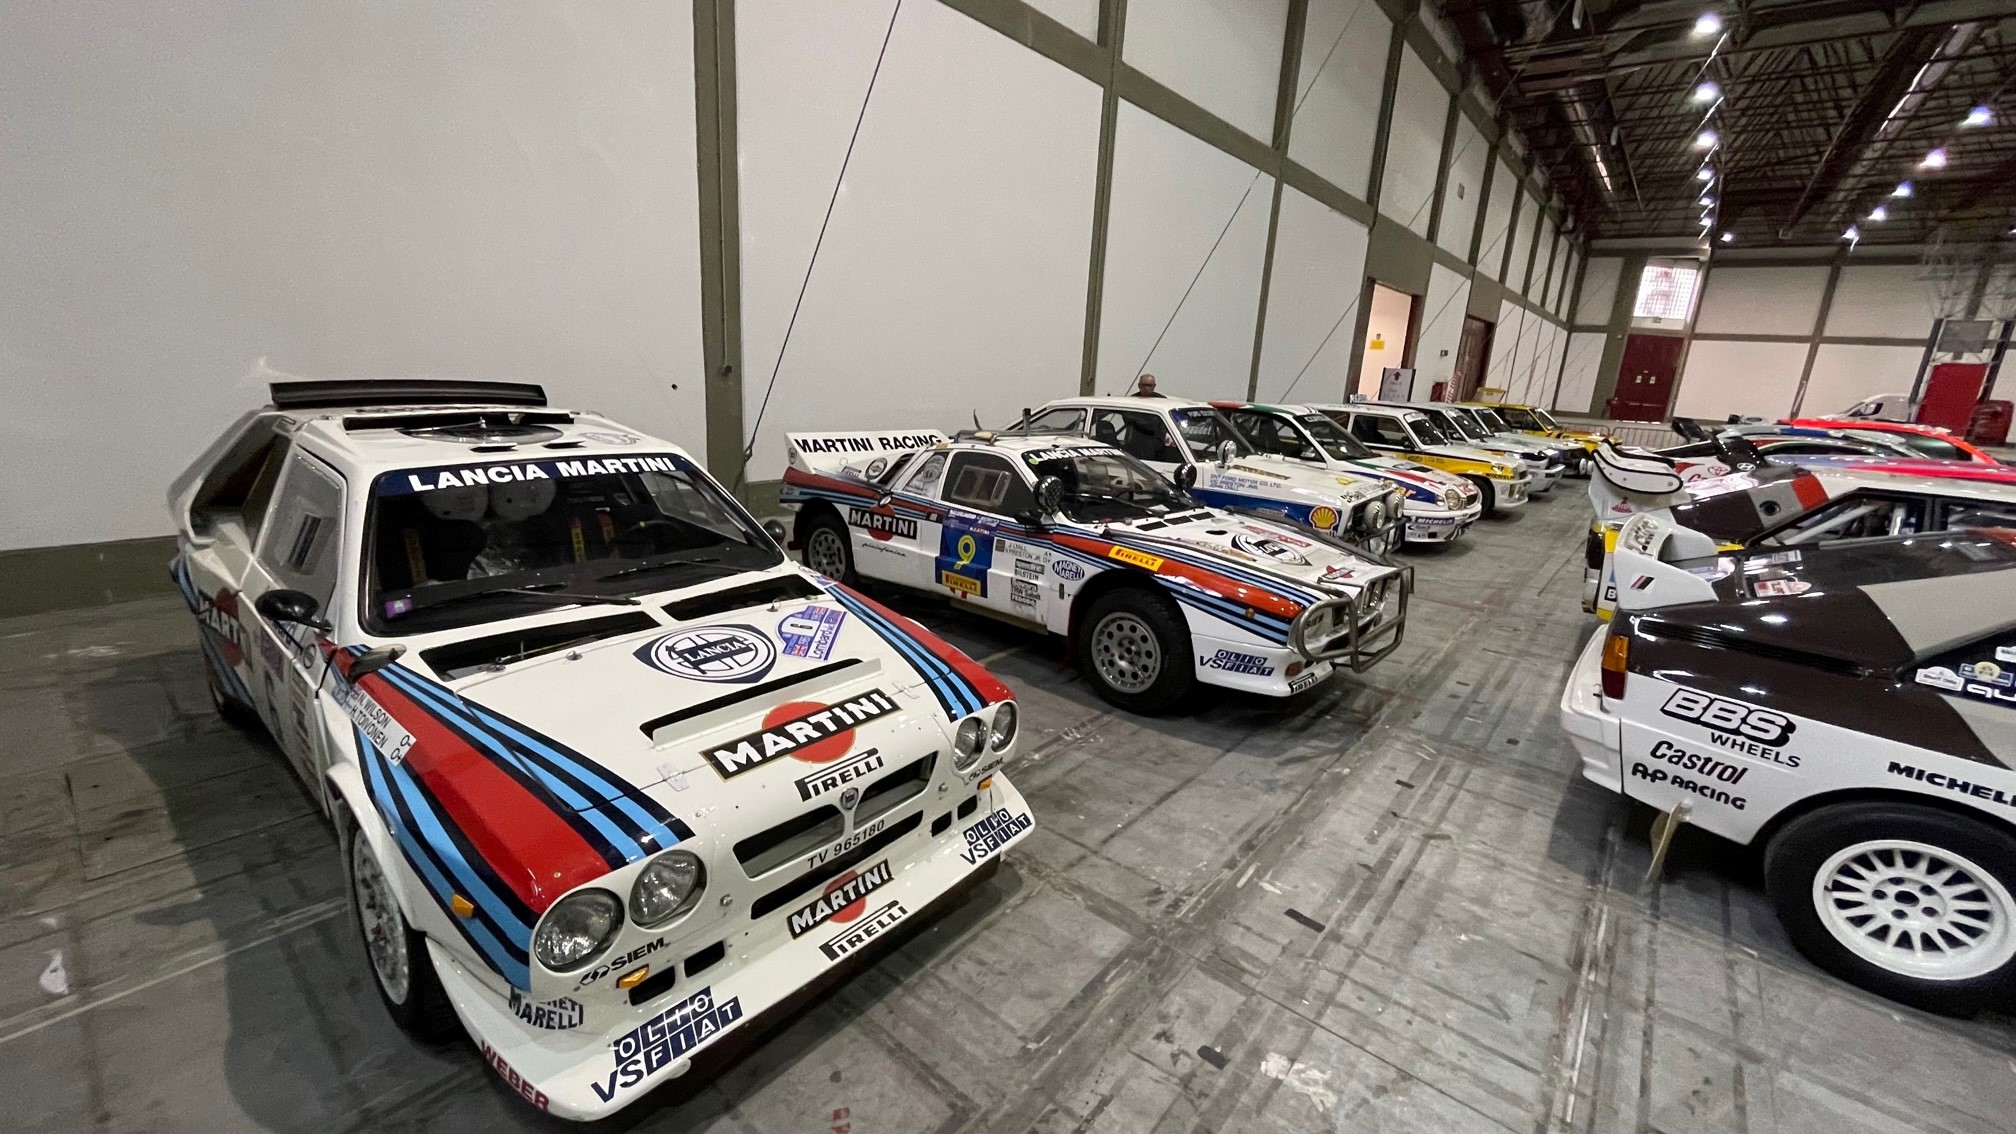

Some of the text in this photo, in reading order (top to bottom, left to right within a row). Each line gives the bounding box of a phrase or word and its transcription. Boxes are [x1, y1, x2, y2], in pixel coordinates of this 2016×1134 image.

[794, 434, 941, 454] MARTINI RACING
[1030, 448, 1082, 463] LANCIA
[408, 457, 677, 492] LANCIA MARTINI
[1238, 477, 1258, 485] MOTOR
[851, 510, 916, 537] MARTINI
[954, 535, 976, 570] 9
[1115, 548, 1158, 567] PIRELLI
[684, 639, 746, 663] LANCIA
[1216, 649, 1266, 666] OLIO
[713, 693, 892, 773] MARTINI
[1660, 688, 1797, 747] BBS
[1650, 740, 1749, 785] Castrol
[1710, 732, 1801, 768] WHEELS
[794, 747, 885, 802] PIRELLI
[1671, 775, 1747, 810] RACING
[807, 819, 885, 869] TV 965180
[964, 809, 1011, 845] OLIO
[791, 863, 889, 934] MARTINI
[819, 900, 909, 962] PIRELLI
[611, 937, 666, 971] SIEM
[616, 988, 713, 1063] OLIO
[480, 1040, 550, 1112] WEBER
